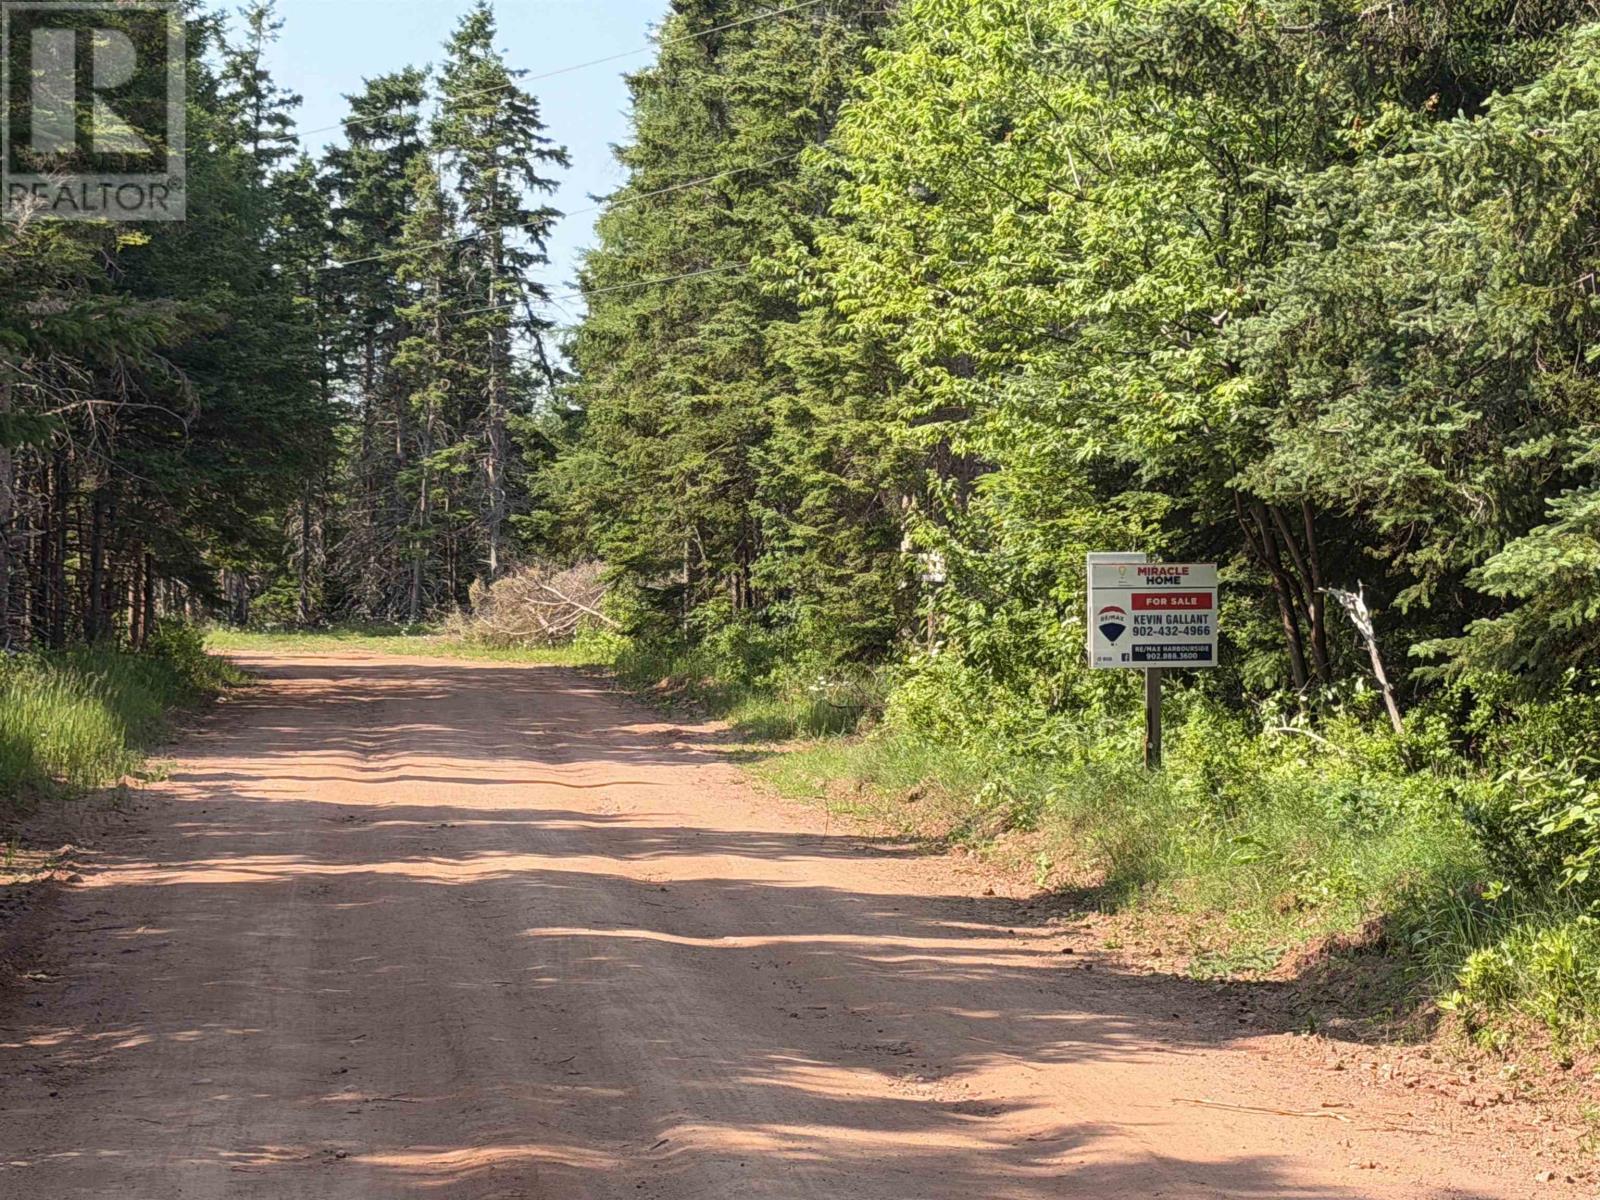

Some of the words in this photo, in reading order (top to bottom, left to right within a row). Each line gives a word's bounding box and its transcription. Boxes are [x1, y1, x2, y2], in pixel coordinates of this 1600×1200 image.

[1137, 566, 1189, 576] MIRACLE
[1146, 576, 1181, 585] HOME
[1146, 597, 1167, 606] FOR
[1171, 597, 1197, 605] SALE
[1133, 614, 1162, 625] KEVIN
[1166, 614, 1209, 624] GALLANT
[1132, 626, 1210, 636] 902-432-4966
